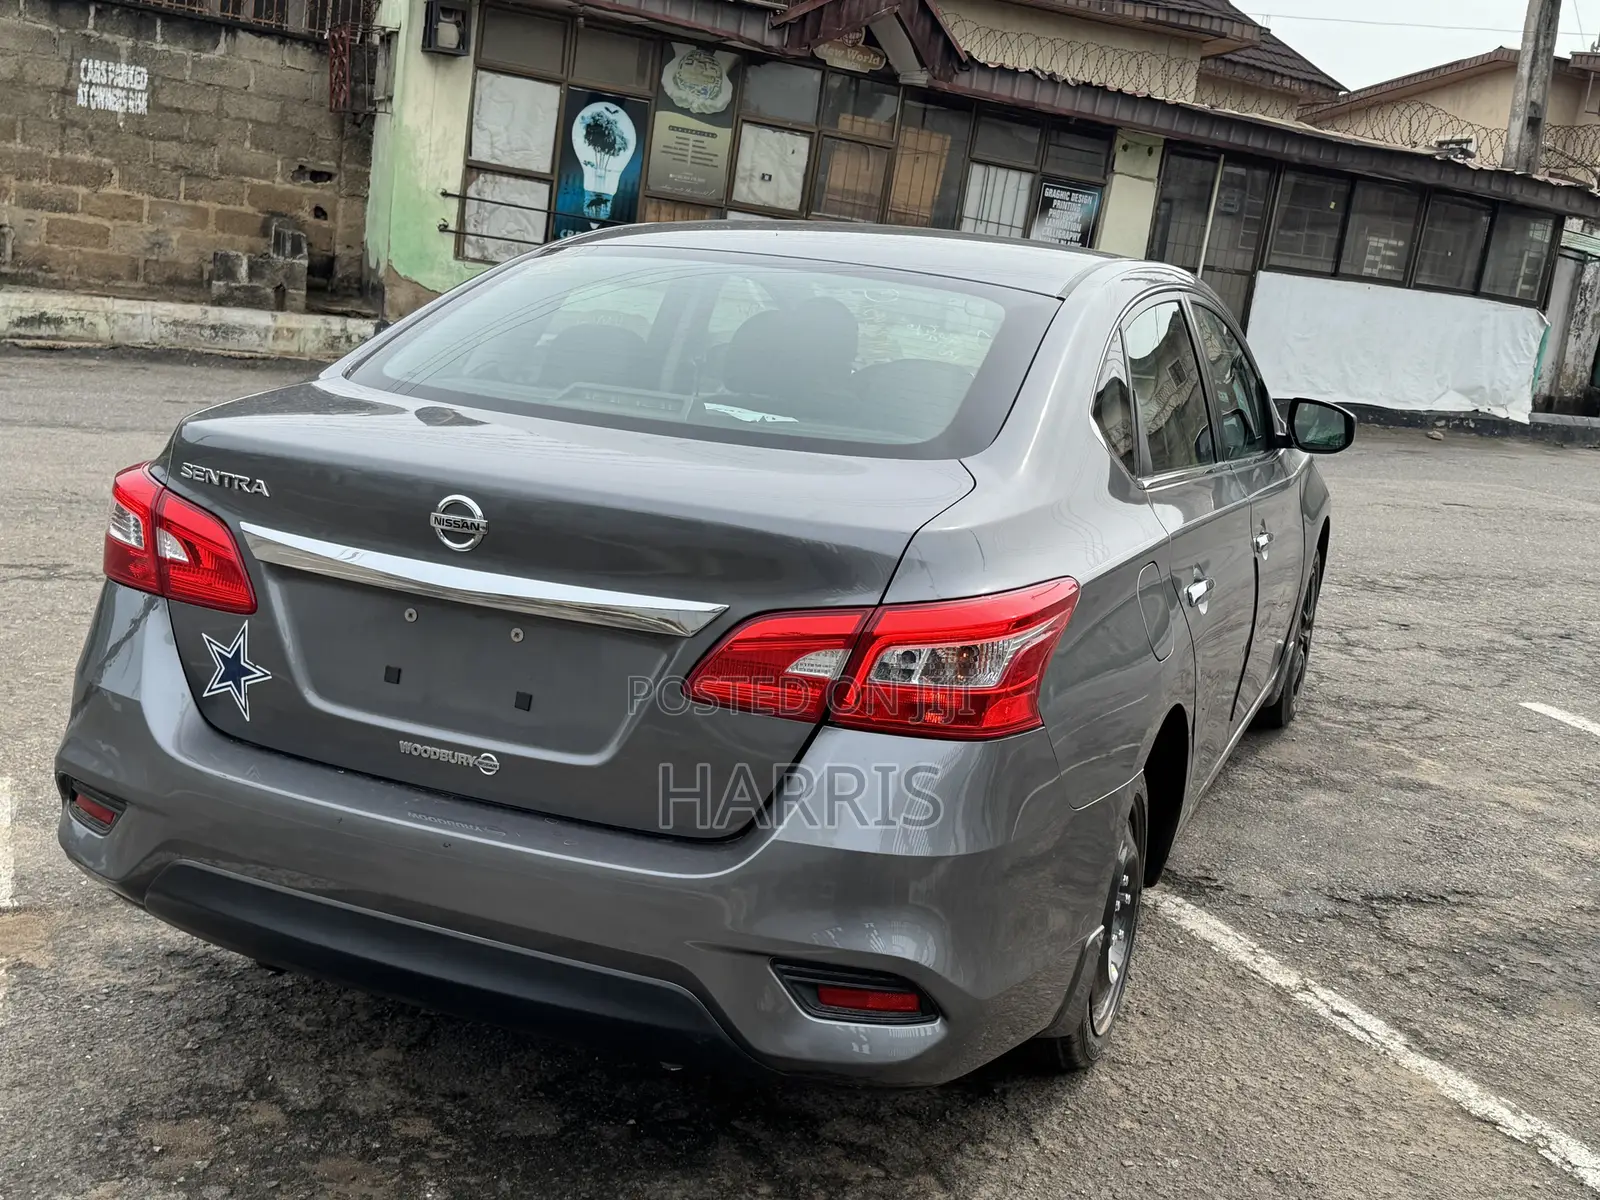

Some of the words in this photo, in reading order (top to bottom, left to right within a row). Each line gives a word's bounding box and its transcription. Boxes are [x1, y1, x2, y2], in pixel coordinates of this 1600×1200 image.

[847, 48, 880, 64] World
[76, 83, 89, 108] AT
[1071, 192, 1093, 204] DESIGN
[180, 462, 269, 497] SENTRA
[433, 516, 480, 531] NISSAN
[399, 740, 477, 767] WOODBURY
